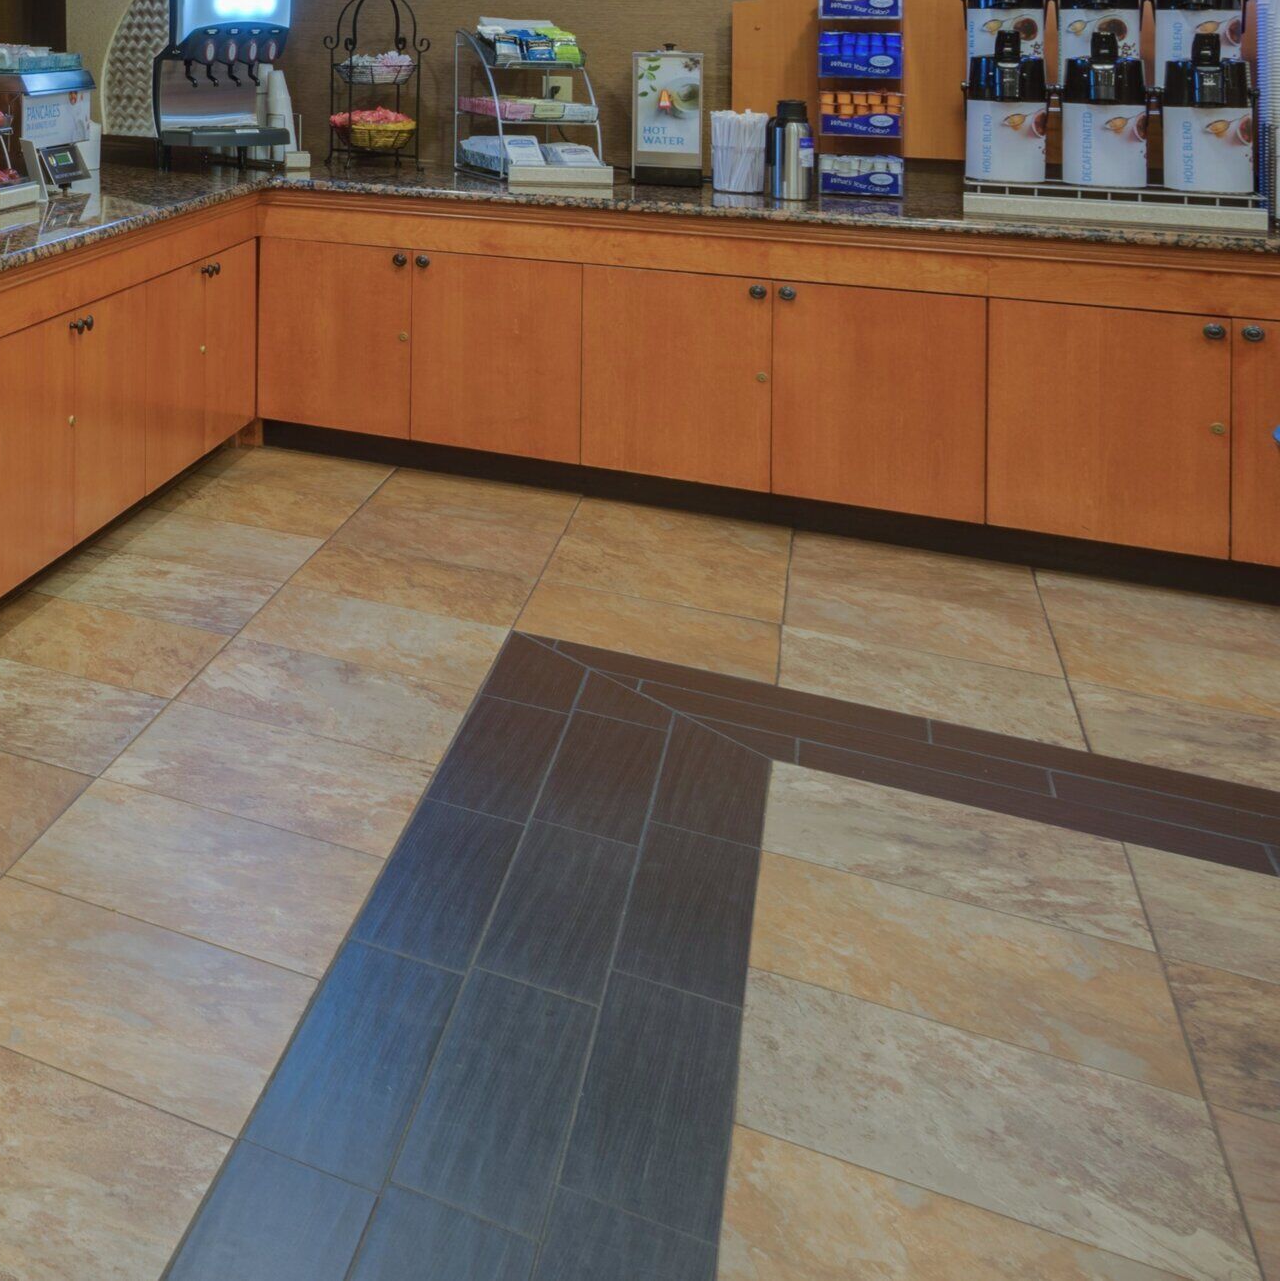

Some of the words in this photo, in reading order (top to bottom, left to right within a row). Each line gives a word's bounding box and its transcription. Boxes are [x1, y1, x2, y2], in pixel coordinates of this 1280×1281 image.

[26, 103, 60, 121] PANCAKES
[643, 126, 667, 135] HOT
[643, 136, 684, 145] WATER
[982, 113, 993, 143] BLEND
[1182, 120, 1193, 151] BLEND
[982, 144, 993, 174] HOUSE
[1082, 112, 1093, 182] DECAFFEINATED
[1182, 152, 1194, 184] HOUSE
